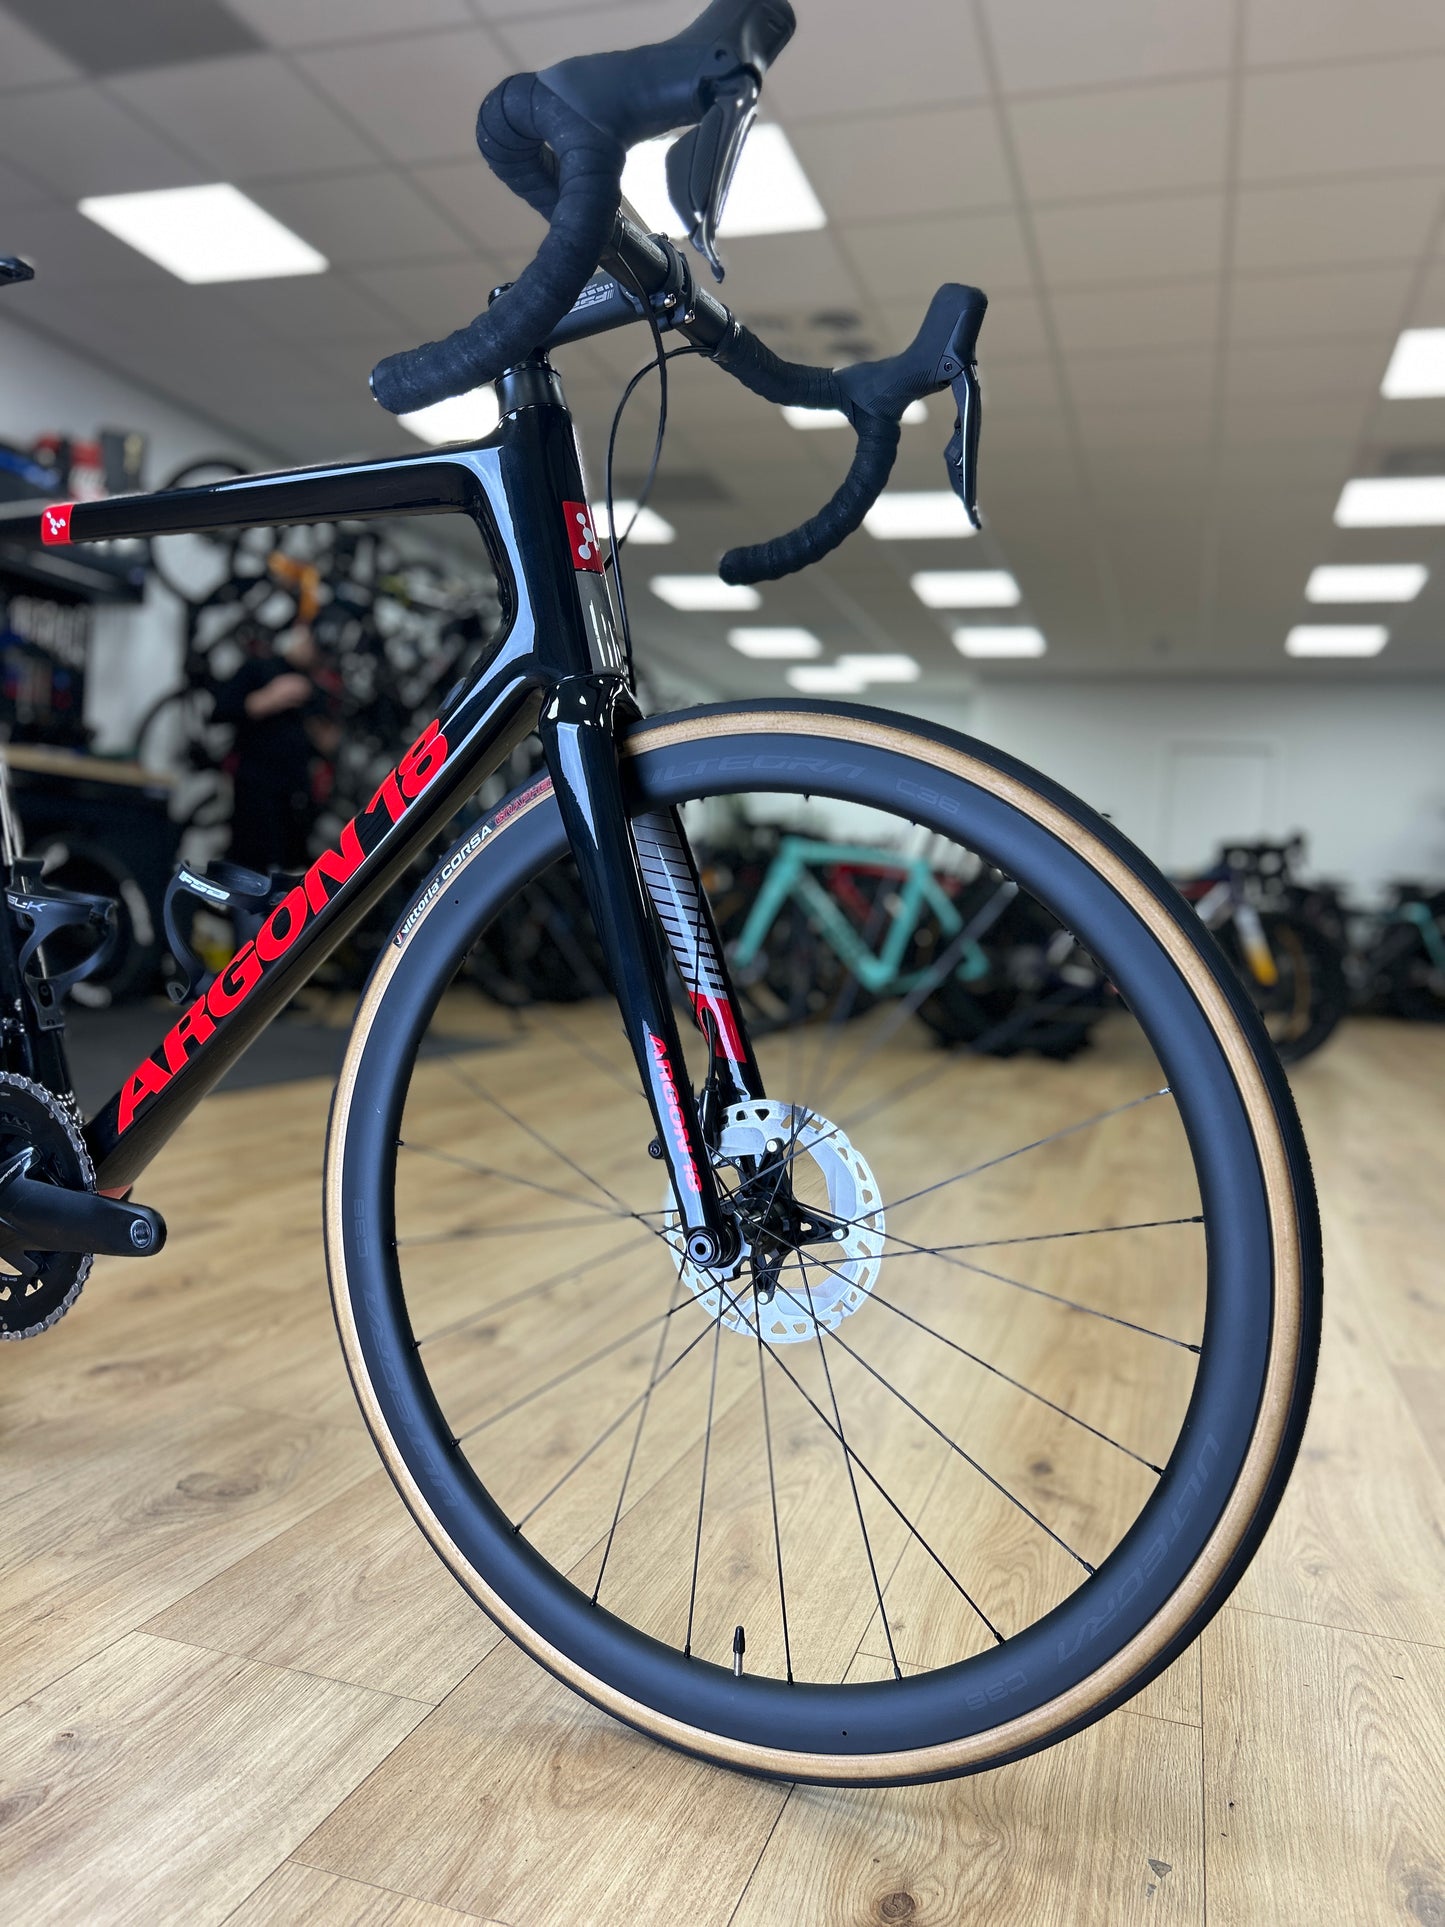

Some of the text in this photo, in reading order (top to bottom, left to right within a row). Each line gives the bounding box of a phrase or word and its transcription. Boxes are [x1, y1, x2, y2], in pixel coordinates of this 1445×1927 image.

[116, 718, 448, 1133] ARGON 18
[441, 825, 492, 880] CORSA
[649, 1032, 703, 1193] ARGON 18
[1056, 1432, 1221, 1665] ULTEGRA
